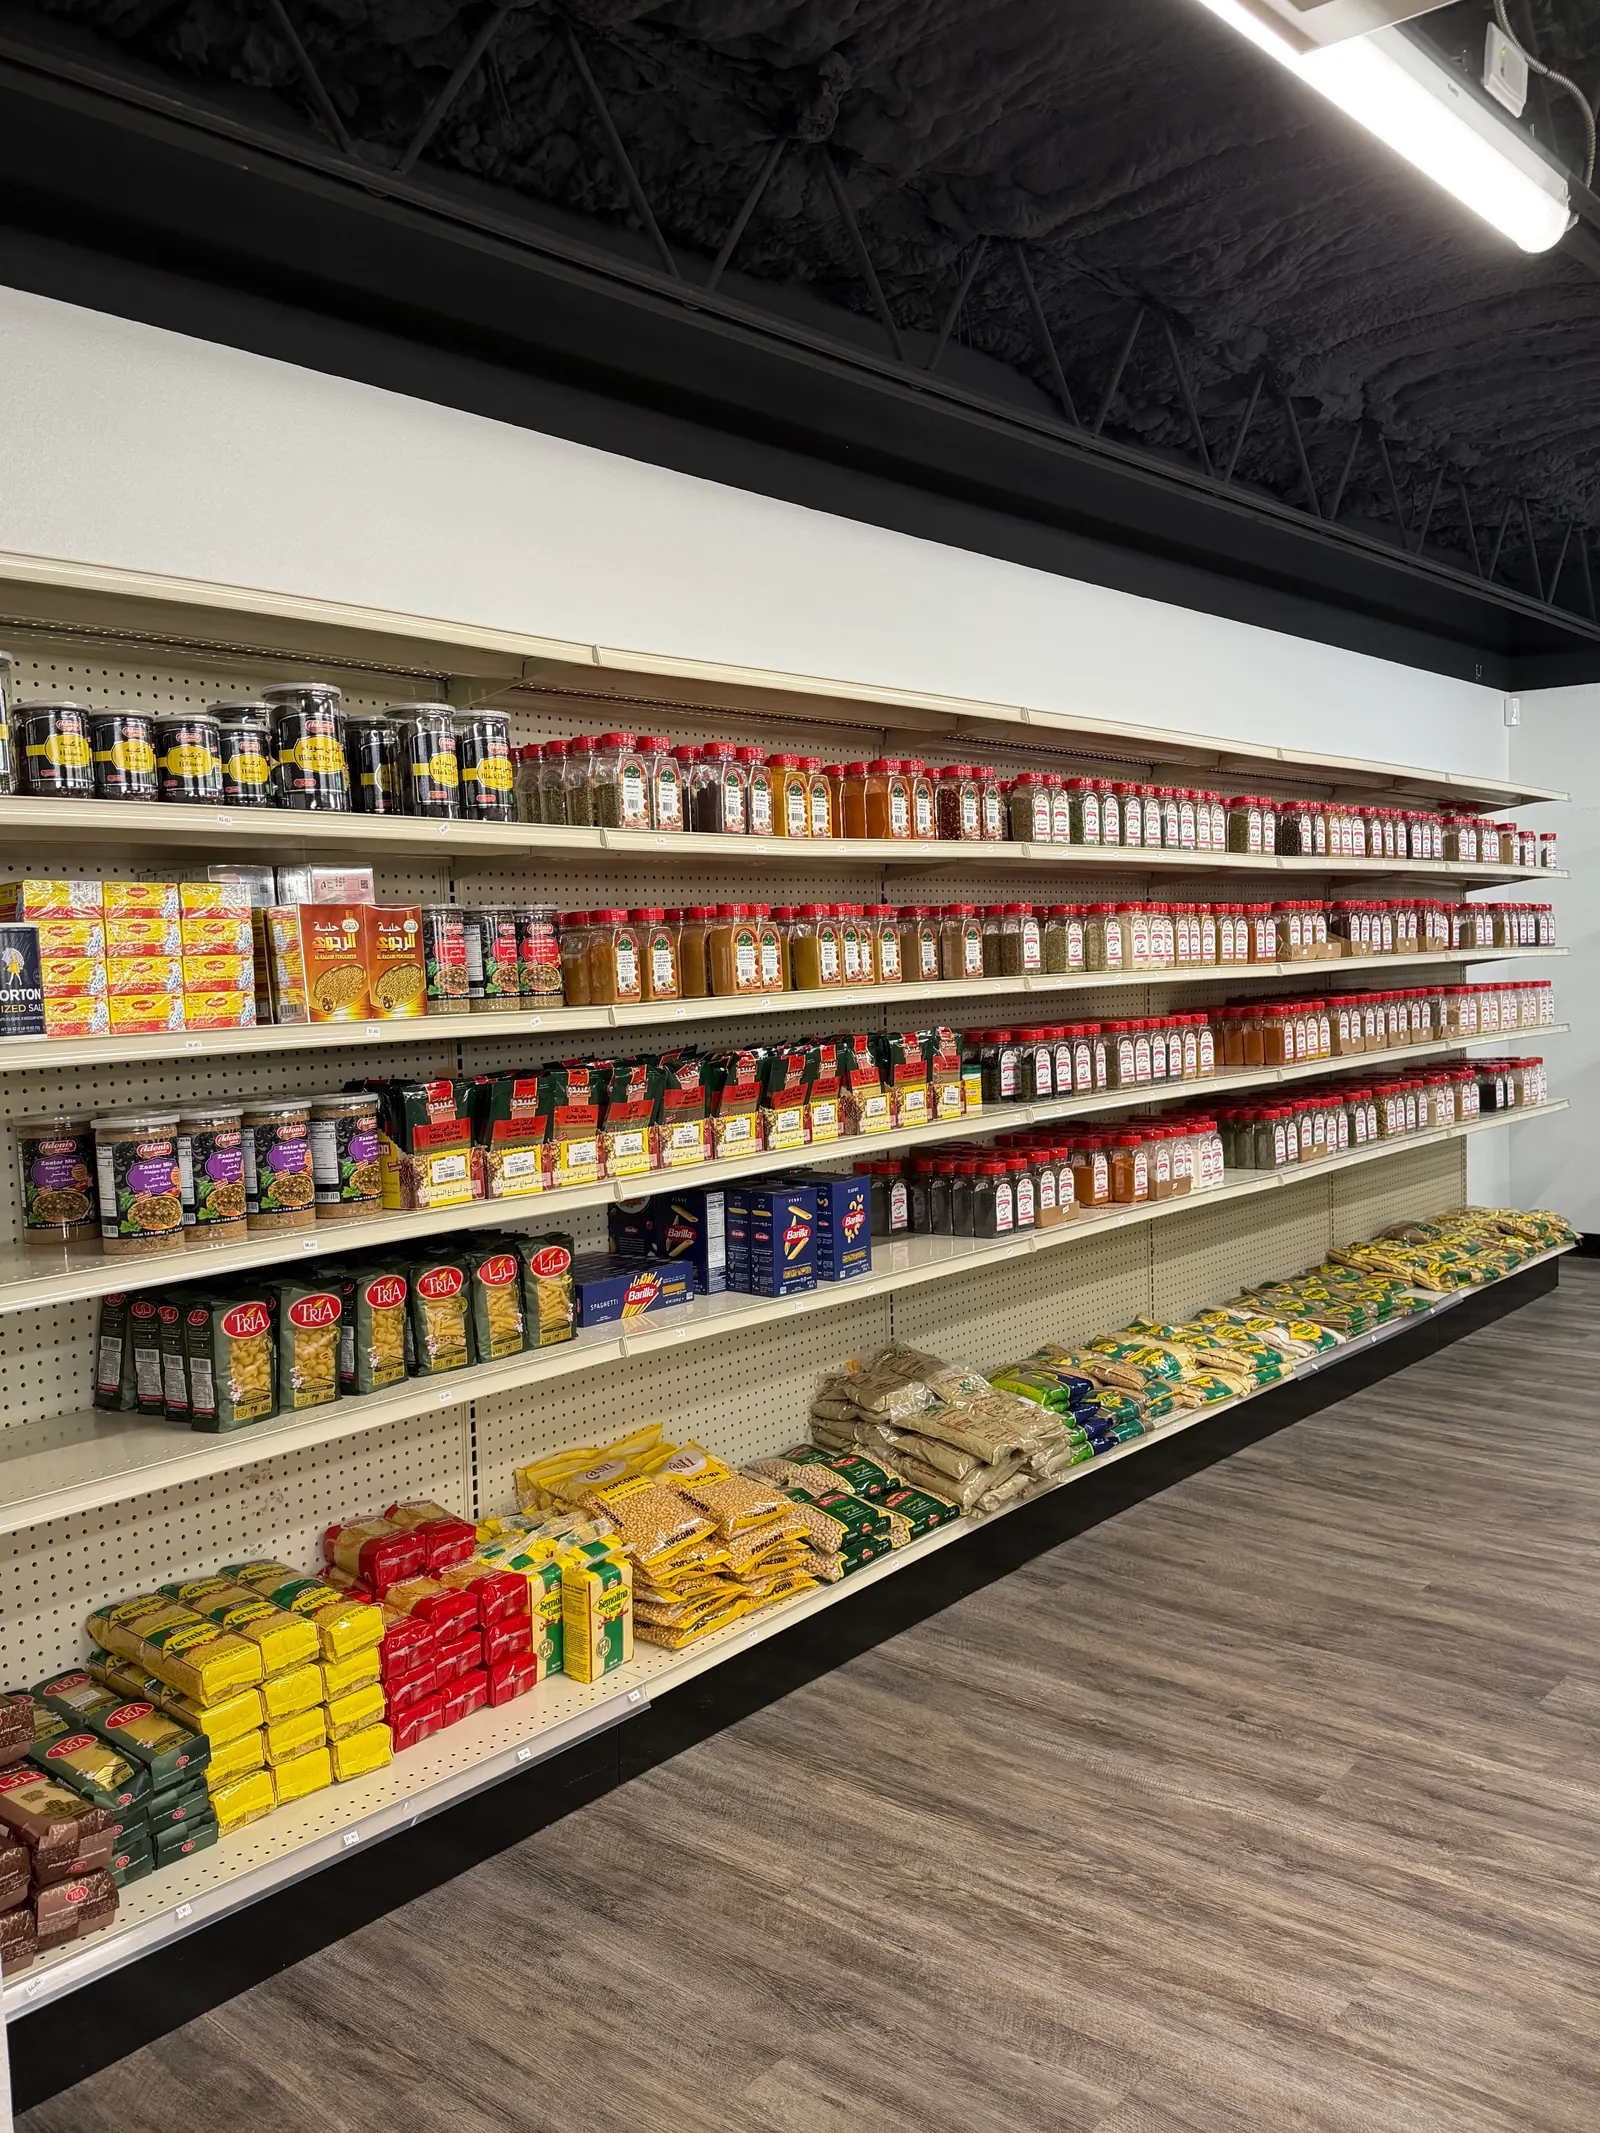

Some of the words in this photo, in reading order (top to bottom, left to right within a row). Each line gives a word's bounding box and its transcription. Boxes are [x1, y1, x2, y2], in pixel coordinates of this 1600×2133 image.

[313, 921, 340, 936] حلبة
[378, 921, 402, 936] حلبة
[312, 933, 356, 953] الرجوي
[375, 933, 416, 952] الرجوي
[0, 989, 41, 1001] ORTON
[1, 1004, 27, 1013] IZED
[568, 1086, 590, 1096] عبيدو
[428, 1100, 455, 1113] عبيدو
[512, 1098, 537, 1109] عبيدو
[41, 1141, 73, 1150] Adonis
[140, 1143, 170, 1153] Adonis
[845, 1214, 864, 1226] Barilla
[667, 1228, 693, 1239] Barilla
[786, 1228, 809, 1240] Barilla
[487, 1259, 515, 1282] ثريا
[539, 1251, 565, 1274] ثريا
[373, 1282, 403, 1304] TRIA
[425, 1273, 458, 1296] TRIA
[628, 1286, 655, 1302] Barilla
[297, 1301, 335, 1323] TRIA
[590, 1298, 619, 1311] SPAGHETTI
[231, 1309, 267, 1334] TRIA
[602, 1474, 641, 1493] POPCORN
[678, 1490, 711, 1514] POPCORN
[594, 1501, 625, 1529] POPCORN
[665, 1528, 696, 1547] OPCORN
[751, 1533, 784, 1555] POPCORN
[540, 1594, 562, 1612] Semol
[598, 1590, 628, 1610] Semolina
[605, 1603, 622, 1614] Coarse
[49, 1674, 87, 1693] TRIA
[110, 1704, 149, 1721] TRIA
[53, 1737, 91, 1754] TRIA
[68, 1887, 87, 1901] TRIA
